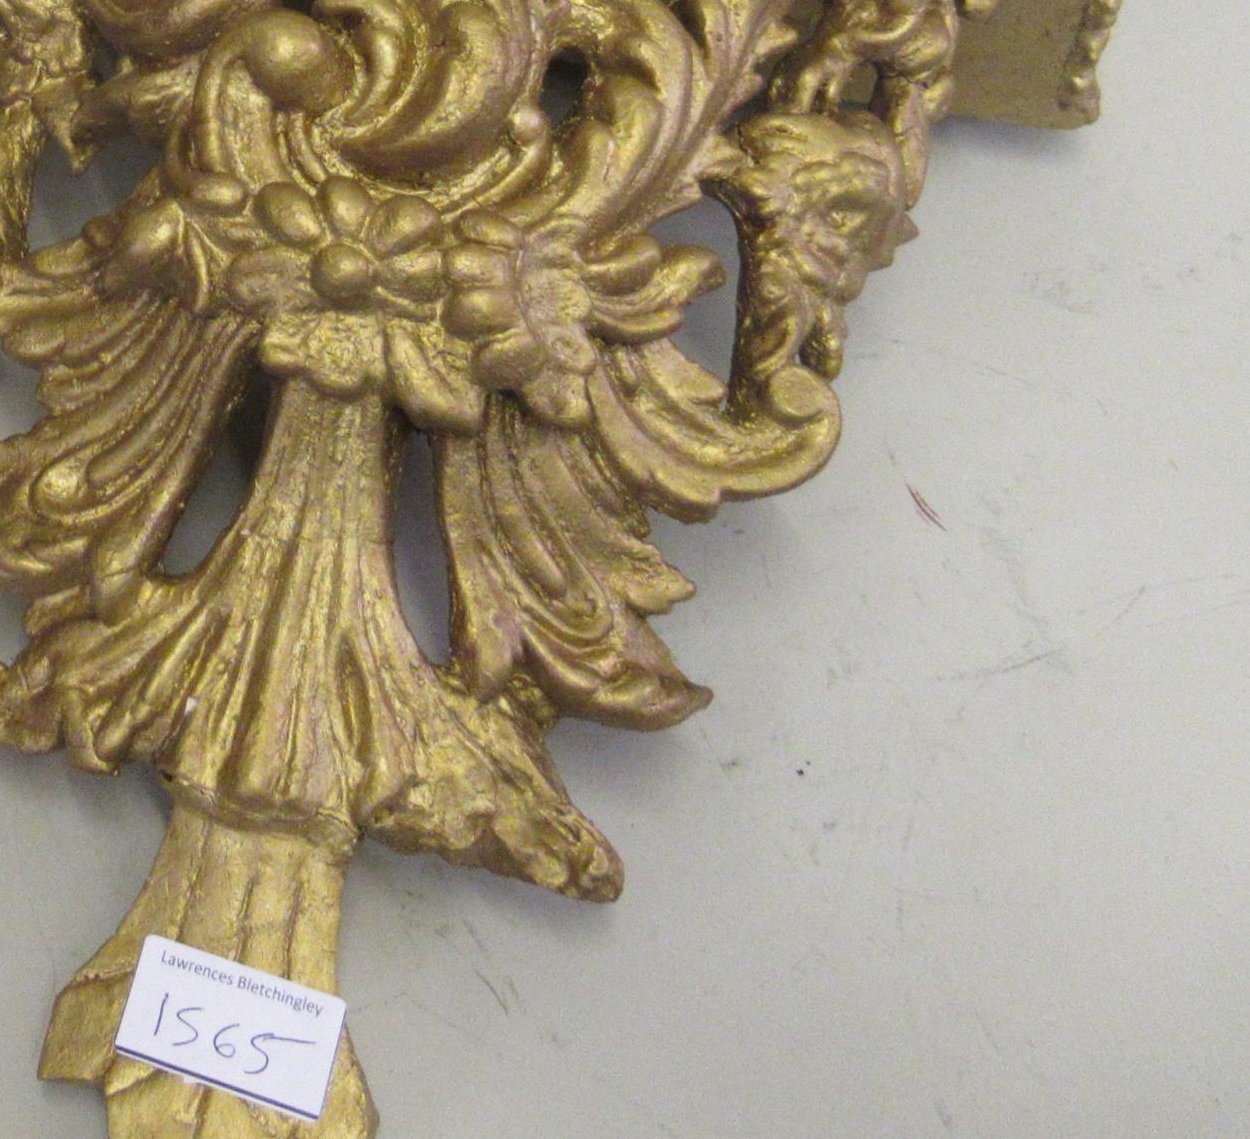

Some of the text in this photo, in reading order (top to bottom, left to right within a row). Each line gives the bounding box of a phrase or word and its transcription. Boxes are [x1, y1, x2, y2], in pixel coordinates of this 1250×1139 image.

[160, 949, 324, 1019] Lawrences Bletchingley
[153, 991, 317, 1076] 1565
